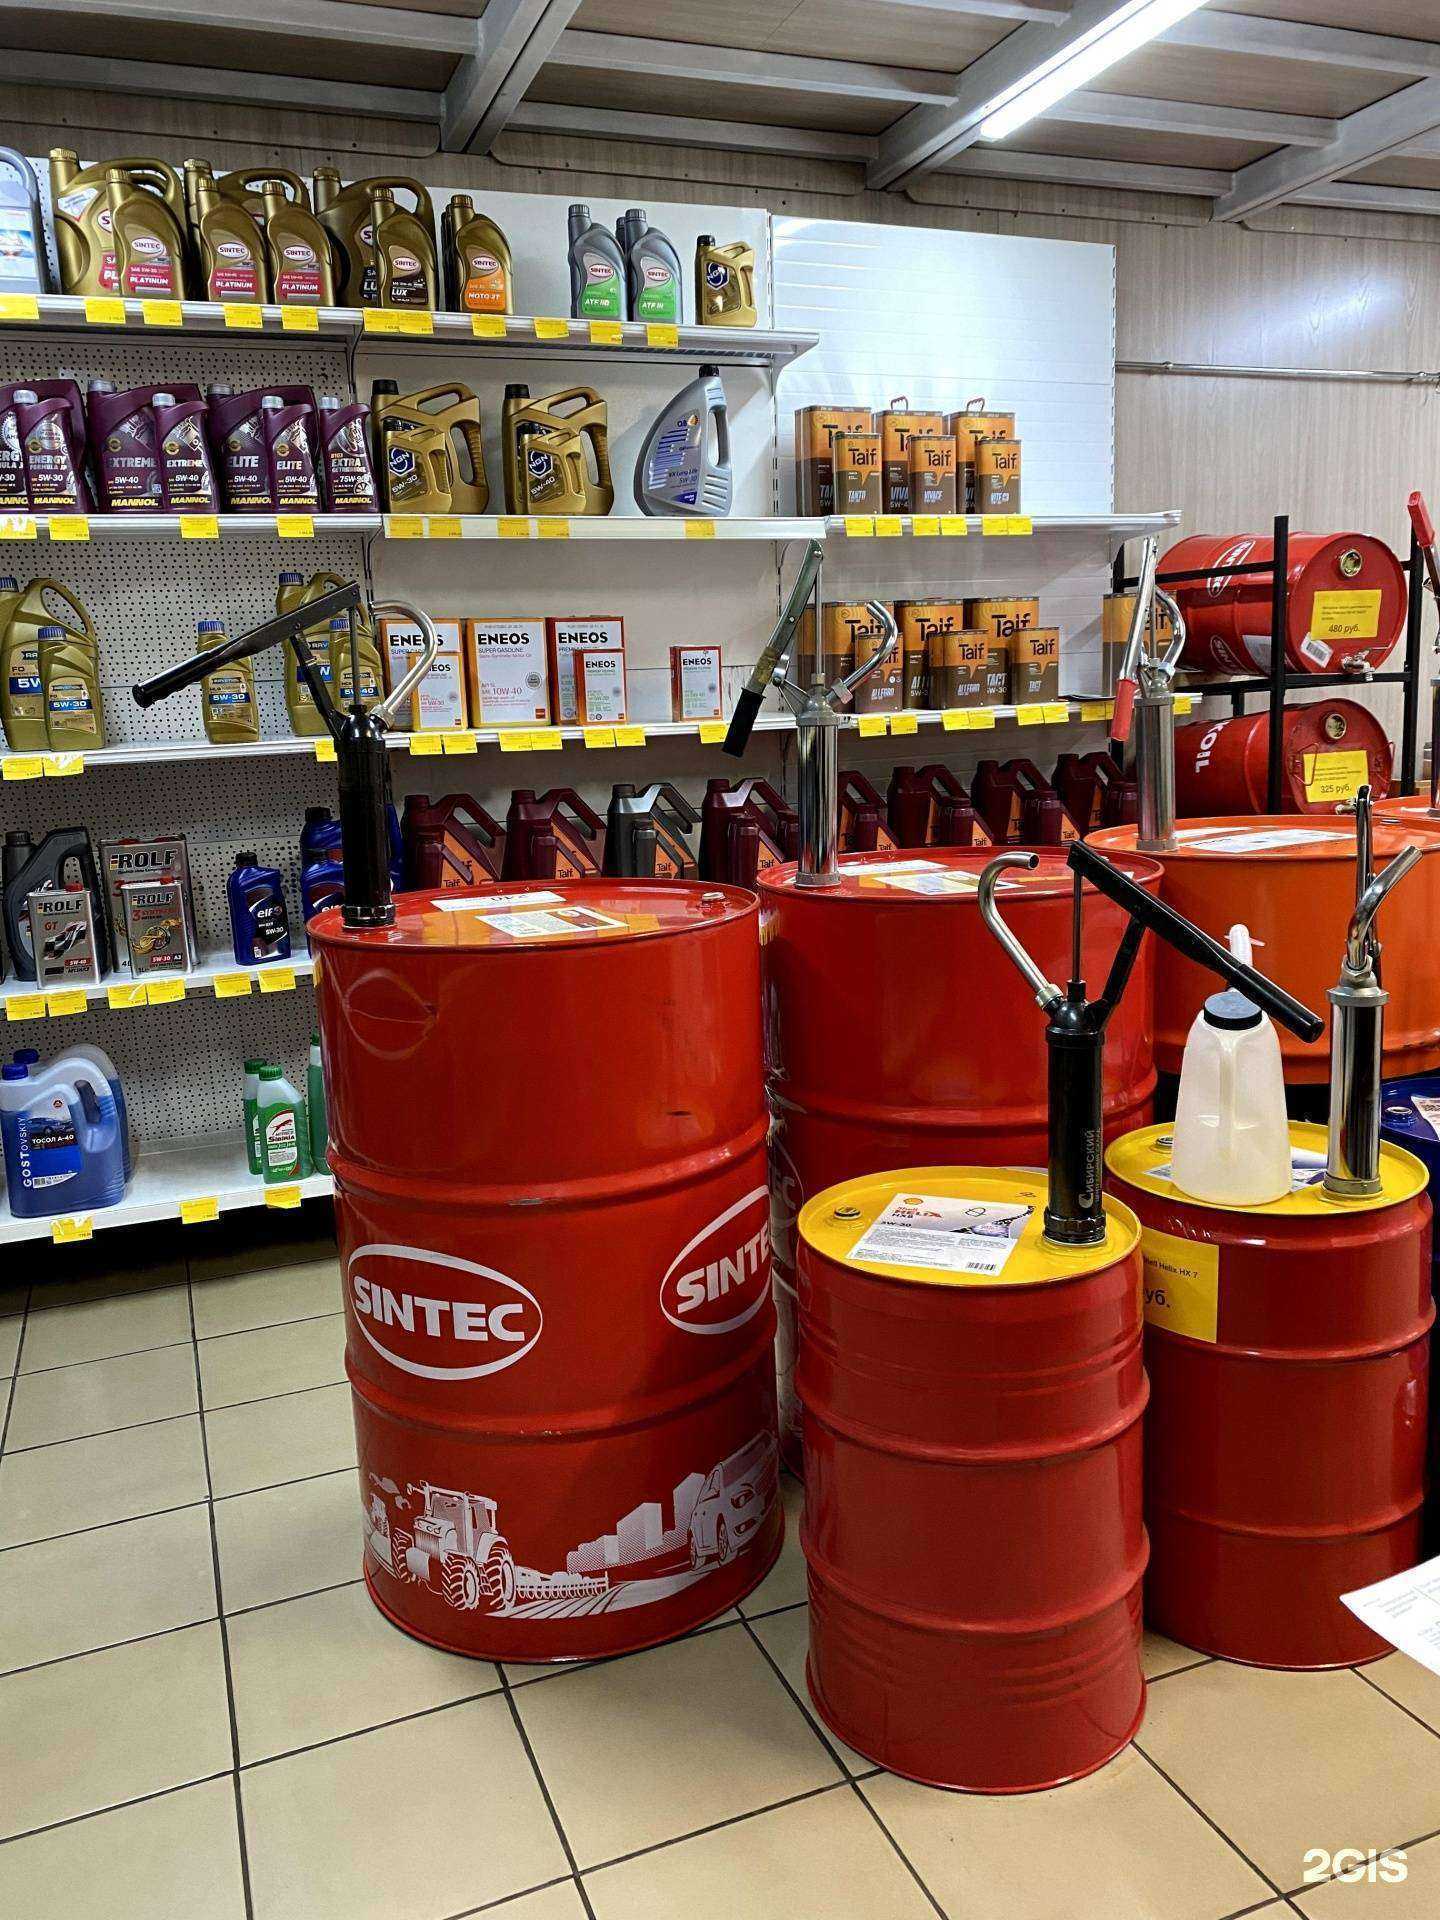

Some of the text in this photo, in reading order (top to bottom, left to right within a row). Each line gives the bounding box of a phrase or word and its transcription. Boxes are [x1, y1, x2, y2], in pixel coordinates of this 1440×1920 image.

[590, 267, 612, 275] SINTEC
[130, 276, 169, 285] PLATINUM
[282, 283, 318, 291] PLATINUM
[391, 288, 408, 296] LUX
[29, 455, 67, 464] ENERGY
[228, 455, 259, 468] ELITE
[389, 451, 410, 467] NGN
[528, 453, 549, 469] NGN
[848, 448, 877, 465] Taif
[924, 449, 952, 466] Taif
[992, 453, 1018, 469] Taif
[276, 460, 302, 470] ELITE
[331, 458, 362, 467] EXTRA
[114, 476, 139, 484] 5W-40
[175, 474, 199, 482] 5W-40
[234, 475, 257, 483] 5W-40
[285, 475, 307, 483] 5W-40
[391, 474, 418, 493] 5W-30
[530, 476, 555, 494] 5W-40
[890, 486, 909, 500] VIVA
[111, 499, 159, 507] MANNOL
[230, 497, 272, 505] MANNO
[279, 497, 317, 505] MANNOL
[1328, 623, 1361, 634] 480 руб.
[389, 634, 444, 647] ENES
[477, 633, 530, 645] ENEOS
[558, 631, 609, 644] ENEOS
[958, 642, 985, 660] Taif
[1030, 638, 1055, 656] Taif
[585, 660, 616, 668] ENEOS
[682, 657, 712, 666] ENEOS
[212, 693, 245, 701] 5W-30
[53, 700, 87, 708] 5W-30
[1320, 783, 1352, 794] 325 руб.
[1062, 830, 1076, 839] Taif
[974, 838, 988, 847] Taif
[118, 849, 178, 869] ROLF
[657, 862, 672, 872] Taif
[759, 860, 774, 869] Taif
[557, 868, 573, 878] Taif
[137, 892, 175, 905] ROLF
[43, 900, 84, 913] ROLF
[257, 907, 274, 918] elf
[44, 921, 58, 931] GT
[265, 926, 284, 935] 5W-30
[32, 1136, 56, 1144] ТОСОЛ
[17, 1117, 32, 1188] GOSTOVSKIY
[675, 1218, 771, 1315] SINTE
[1159, 1262, 1178, 1274] Helix
[1179, 1268, 1191, 1277] HX
[1143, 1287, 1170, 1308] уб.
[352, 1274, 526, 1343] SINTEC
